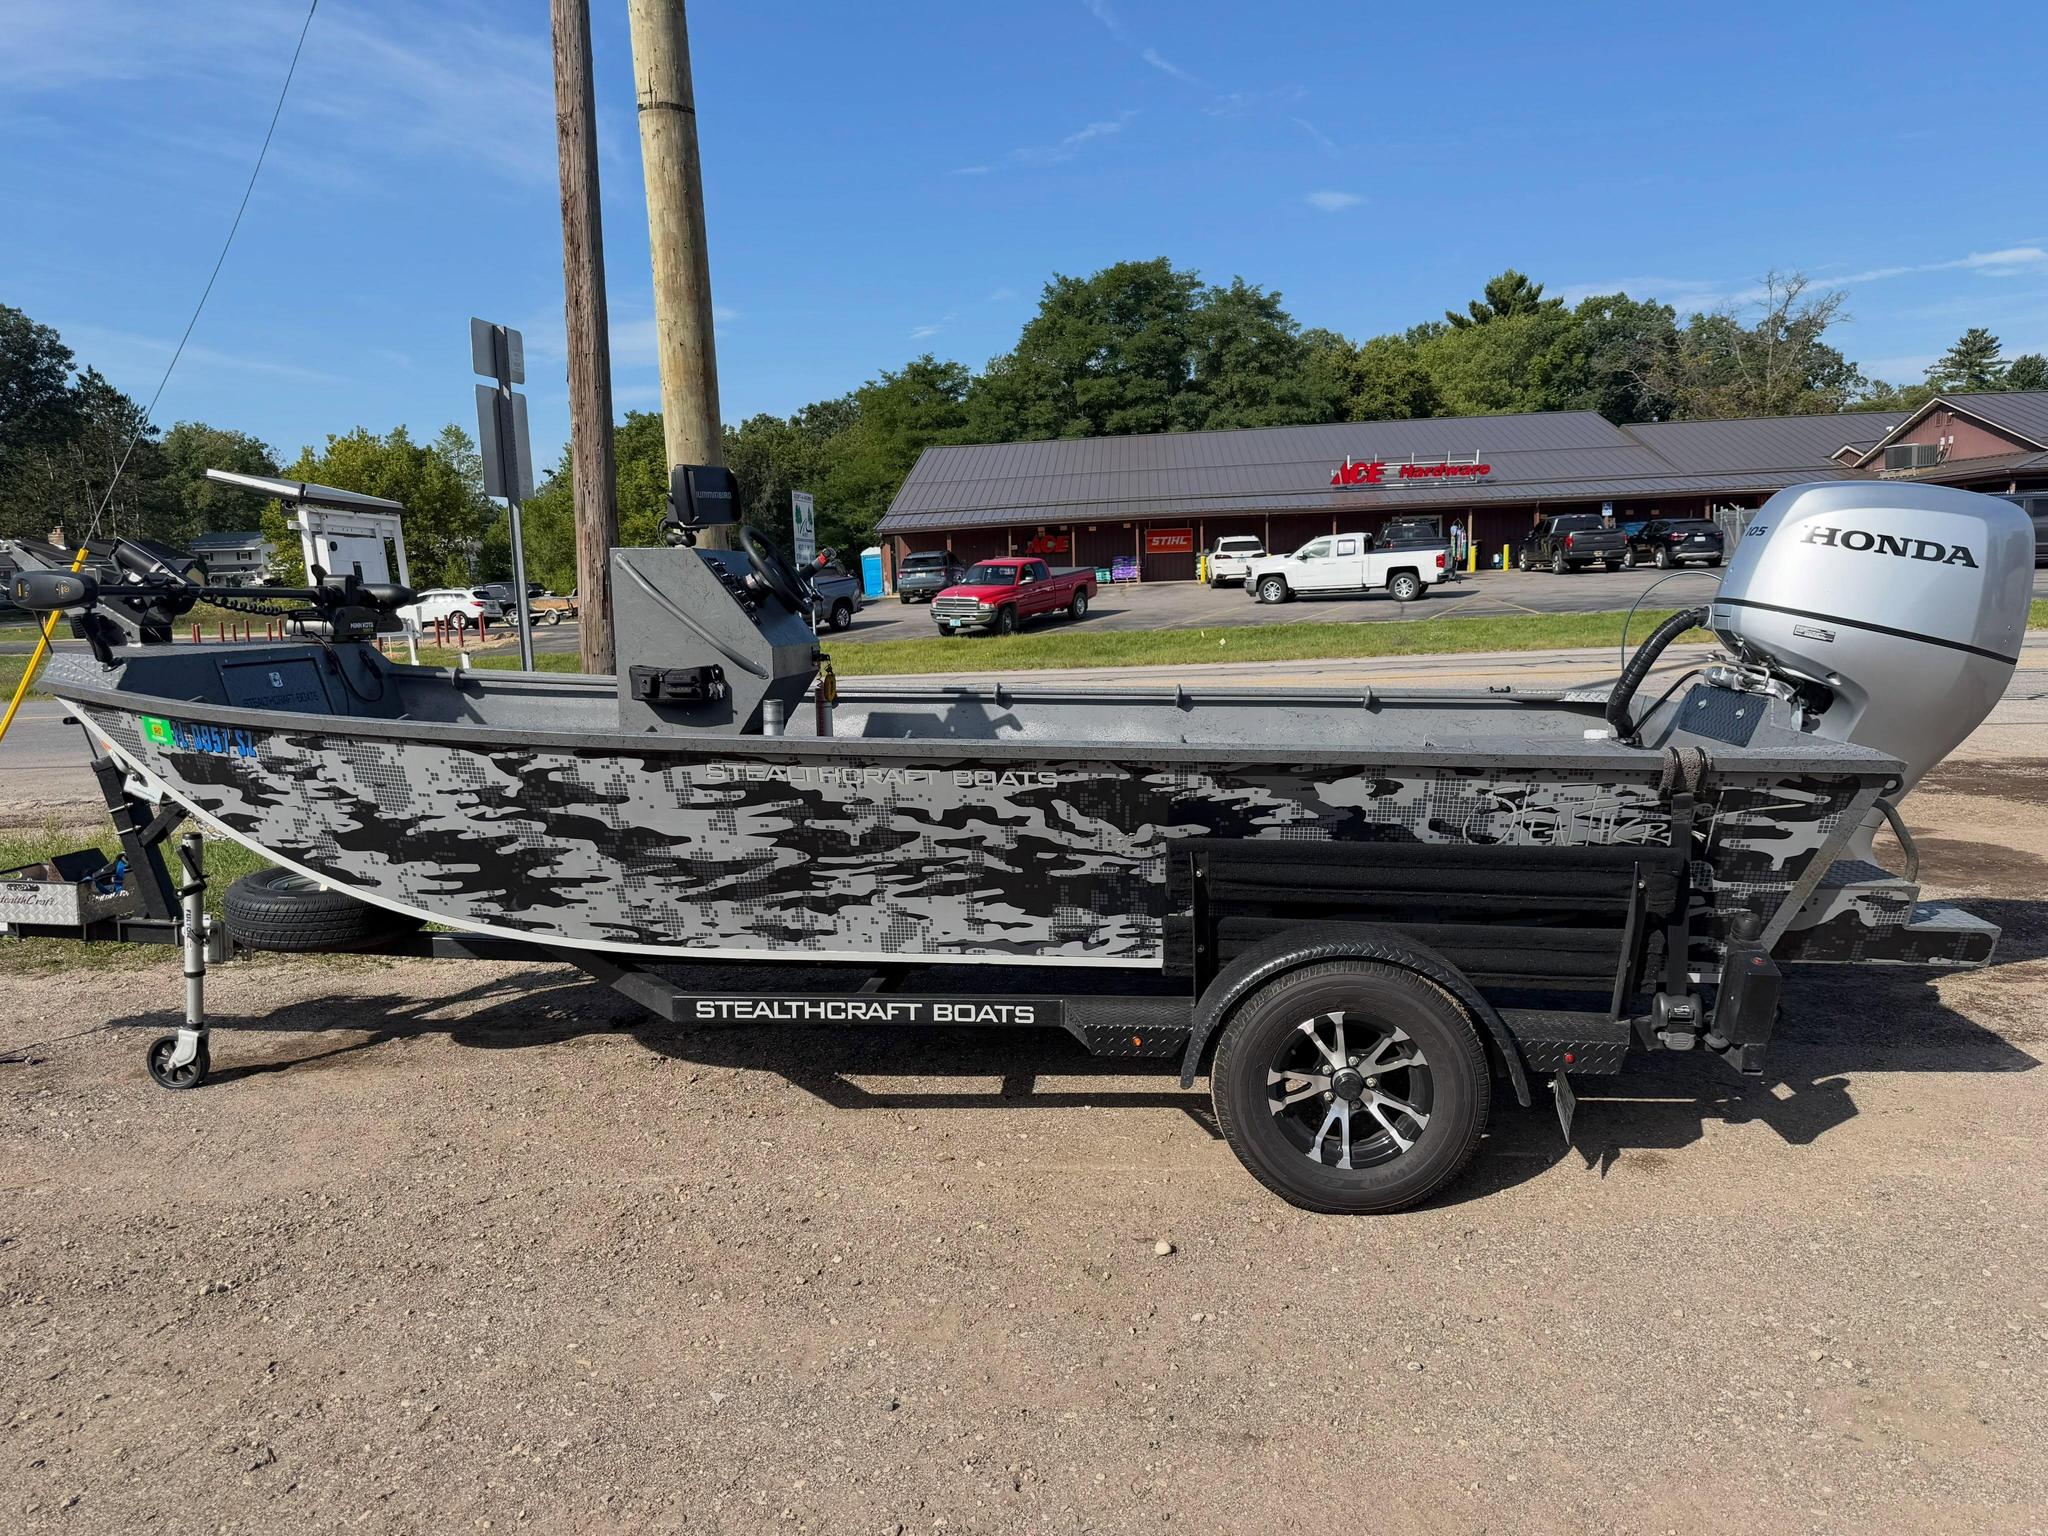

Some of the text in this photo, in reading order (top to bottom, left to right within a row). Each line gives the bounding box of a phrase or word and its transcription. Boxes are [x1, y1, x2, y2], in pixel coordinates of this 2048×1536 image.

[1331, 461, 1491, 485] ACE Hardware
[1151, 536, 1188, 546] STIHL
[1746, 526, 1768, 537] 105
[1025, 534, 1071, 554] ACE
[1800, 525, 1980, 569] HONDA
[705, 763, 1058, 788] STEALTHCRAFT BOATS
[696, 1001, 1035, 1024] STEALTHCRAFT BOATS
